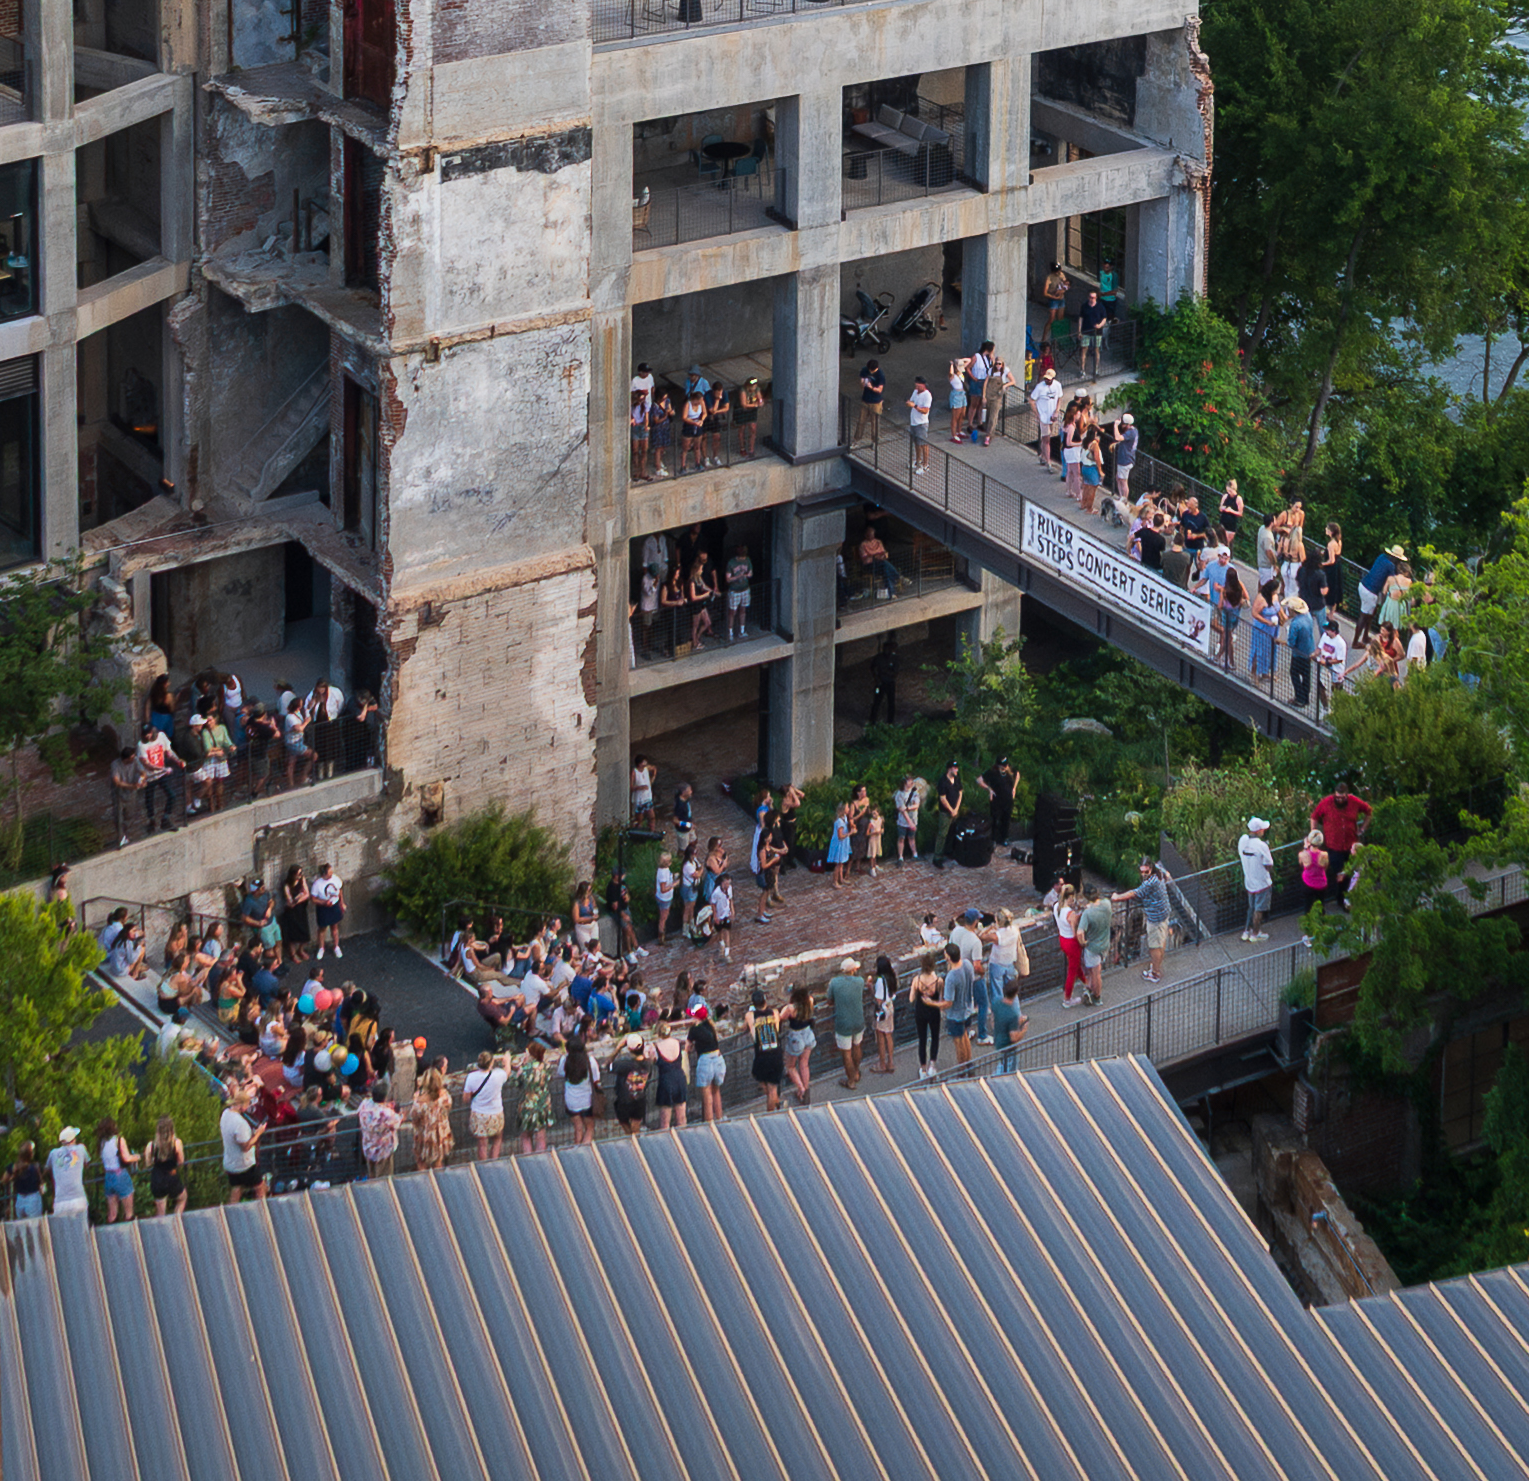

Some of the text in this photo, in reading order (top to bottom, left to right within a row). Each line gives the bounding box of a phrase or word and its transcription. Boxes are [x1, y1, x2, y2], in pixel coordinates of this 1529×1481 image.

[1037, 513, 1073, 548] RIVER
[1037, 534, 1074, 570] STEPS
[1077, 548, 1186, 625] CONCERT SERIES
